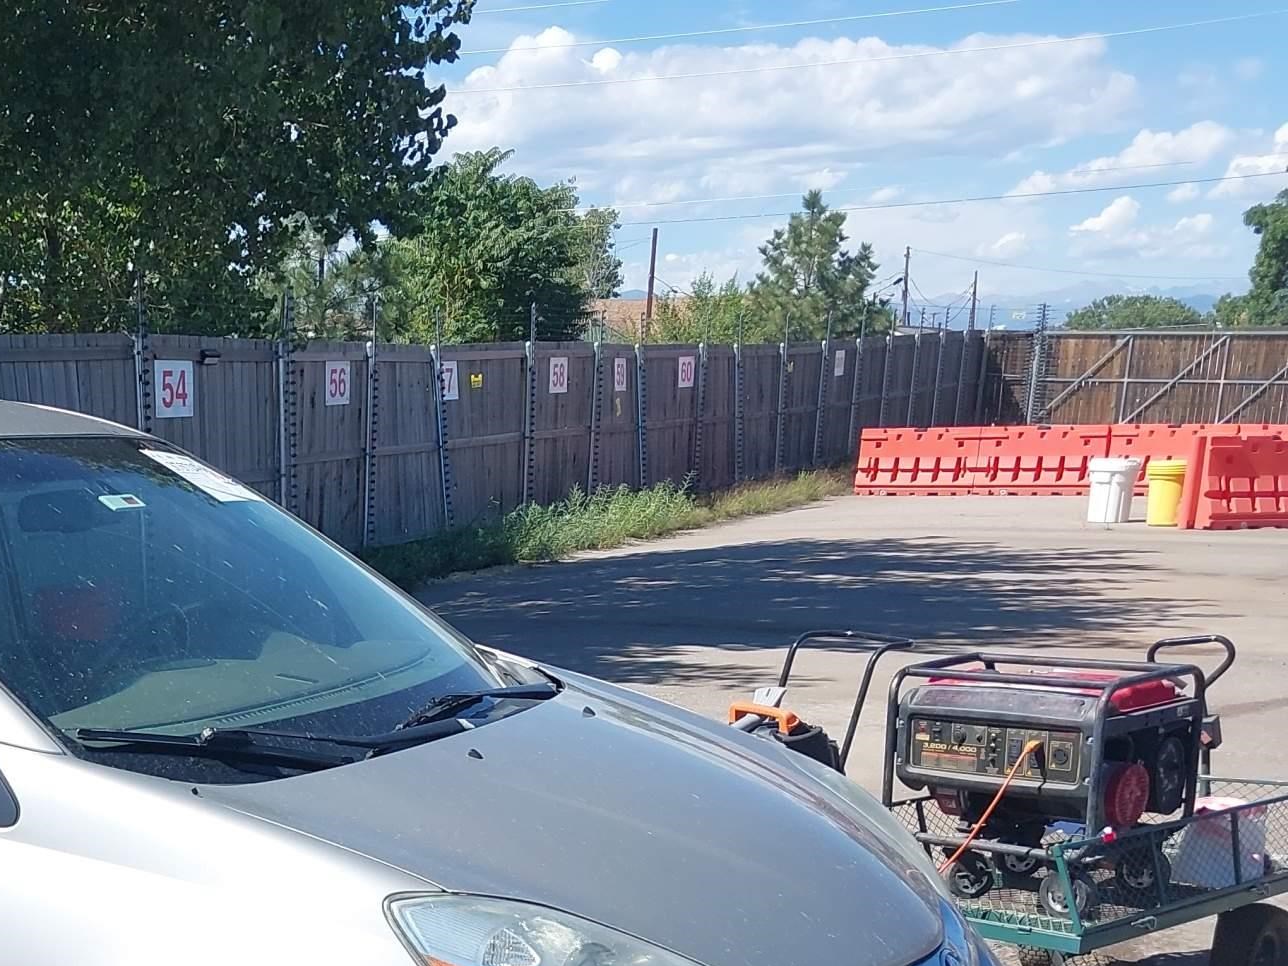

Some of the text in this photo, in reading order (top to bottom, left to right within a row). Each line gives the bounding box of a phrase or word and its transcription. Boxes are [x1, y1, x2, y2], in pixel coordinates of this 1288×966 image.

[329, 368, 346, 397] 56
[552, 363, 565, 387] 58
[616, 363, 624, 385] 59
[681, 361, 692, 382] 60
[162, 369, 188, 408] 54
[952, 745, 977, 753] 4,000
